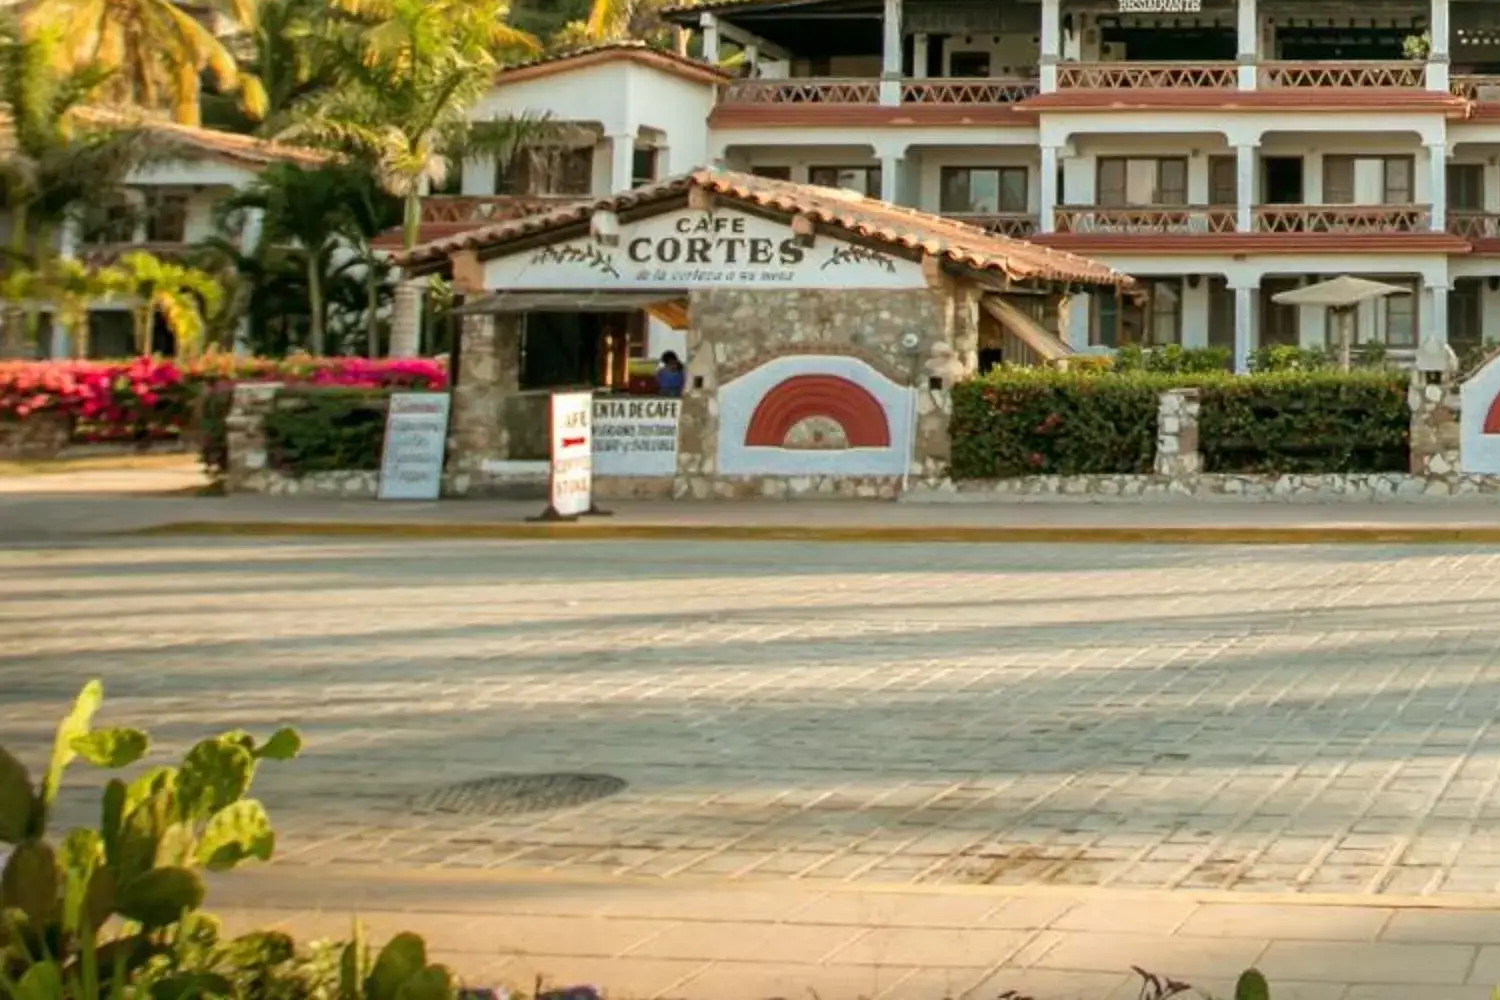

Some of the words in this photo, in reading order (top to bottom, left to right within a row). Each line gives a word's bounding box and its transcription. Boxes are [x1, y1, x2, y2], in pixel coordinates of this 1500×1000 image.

[675, 217, 745, 233] CAFE
[628, 237, 804, 264] CORTES
[592, 401, 625, 418] ENTA
[629, 401, 642, 418] DE
